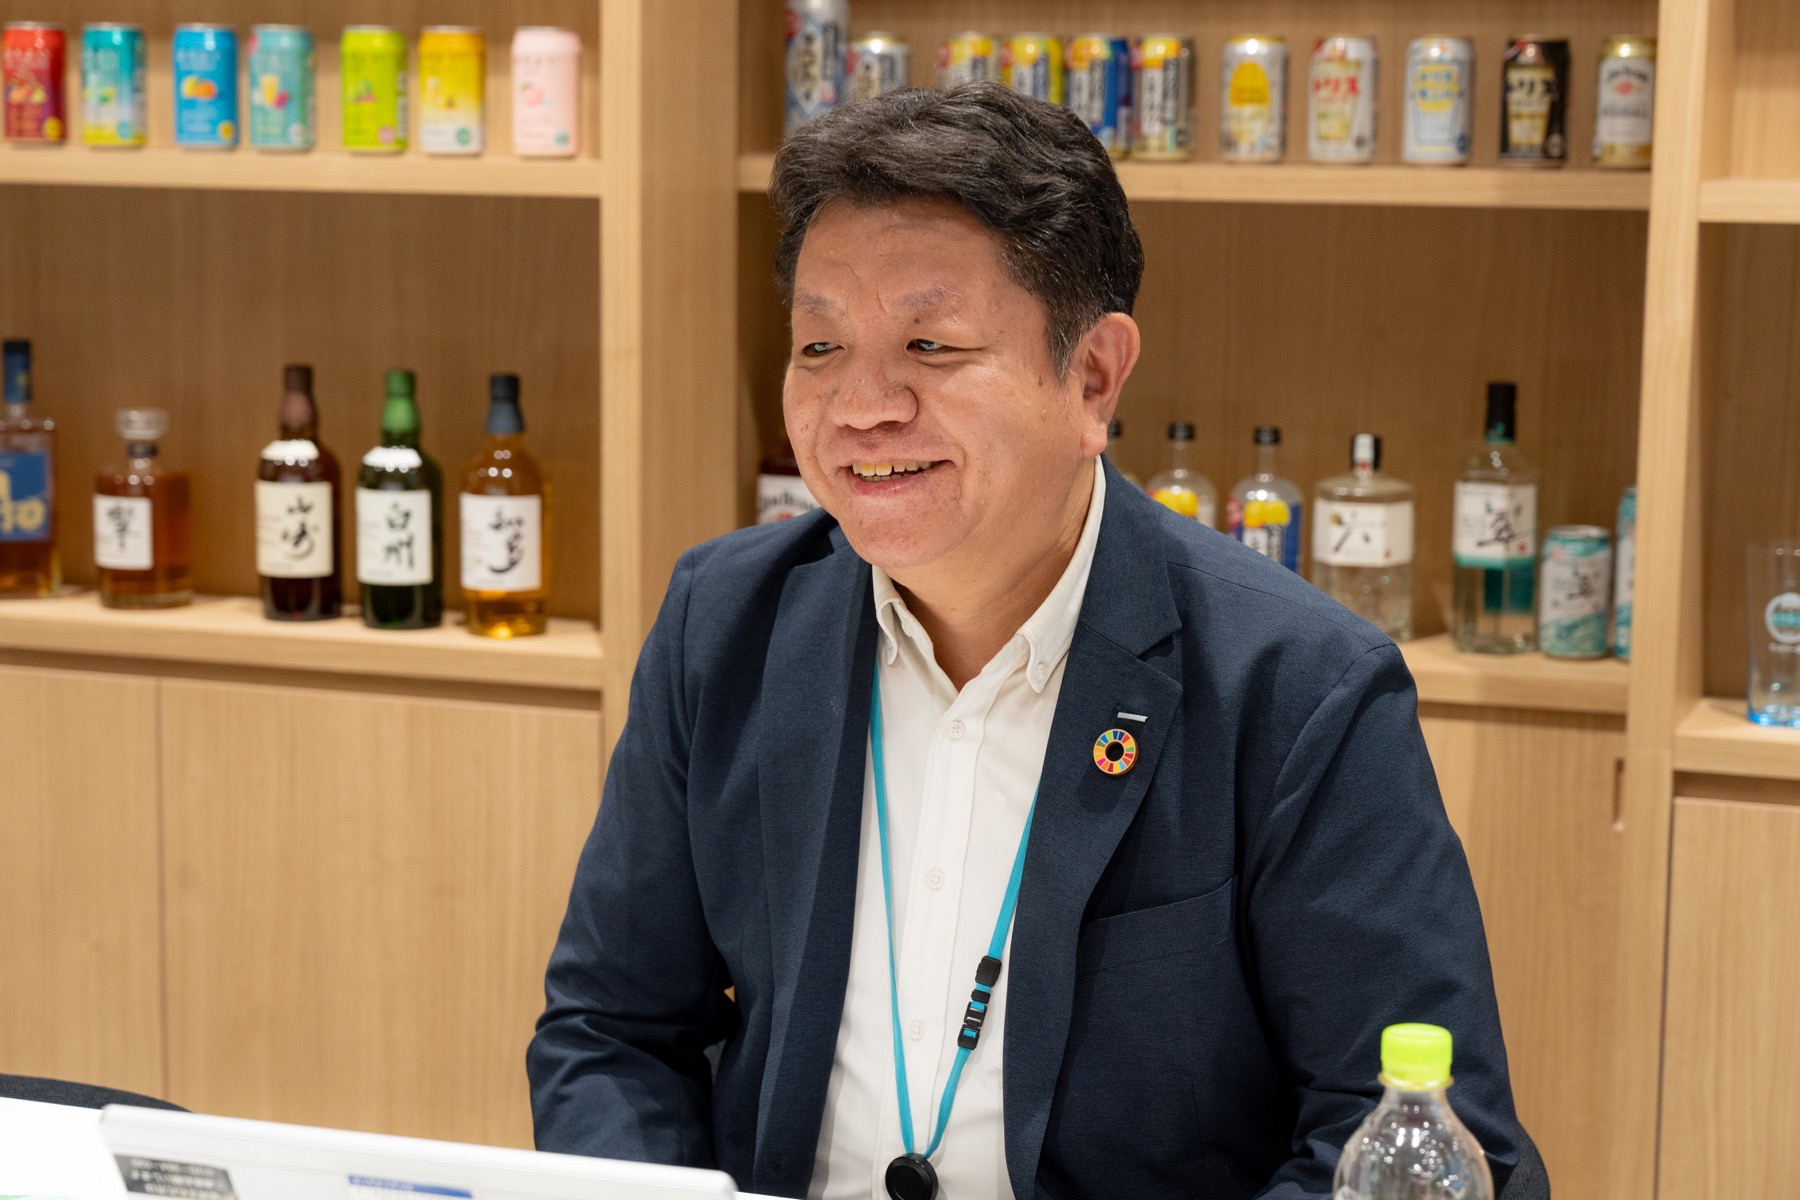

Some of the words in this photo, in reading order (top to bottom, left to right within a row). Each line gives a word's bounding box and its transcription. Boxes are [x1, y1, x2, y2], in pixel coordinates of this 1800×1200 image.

[1312, 76, 1359, 97] トリス
[382, 501, 415, 569] 白州
